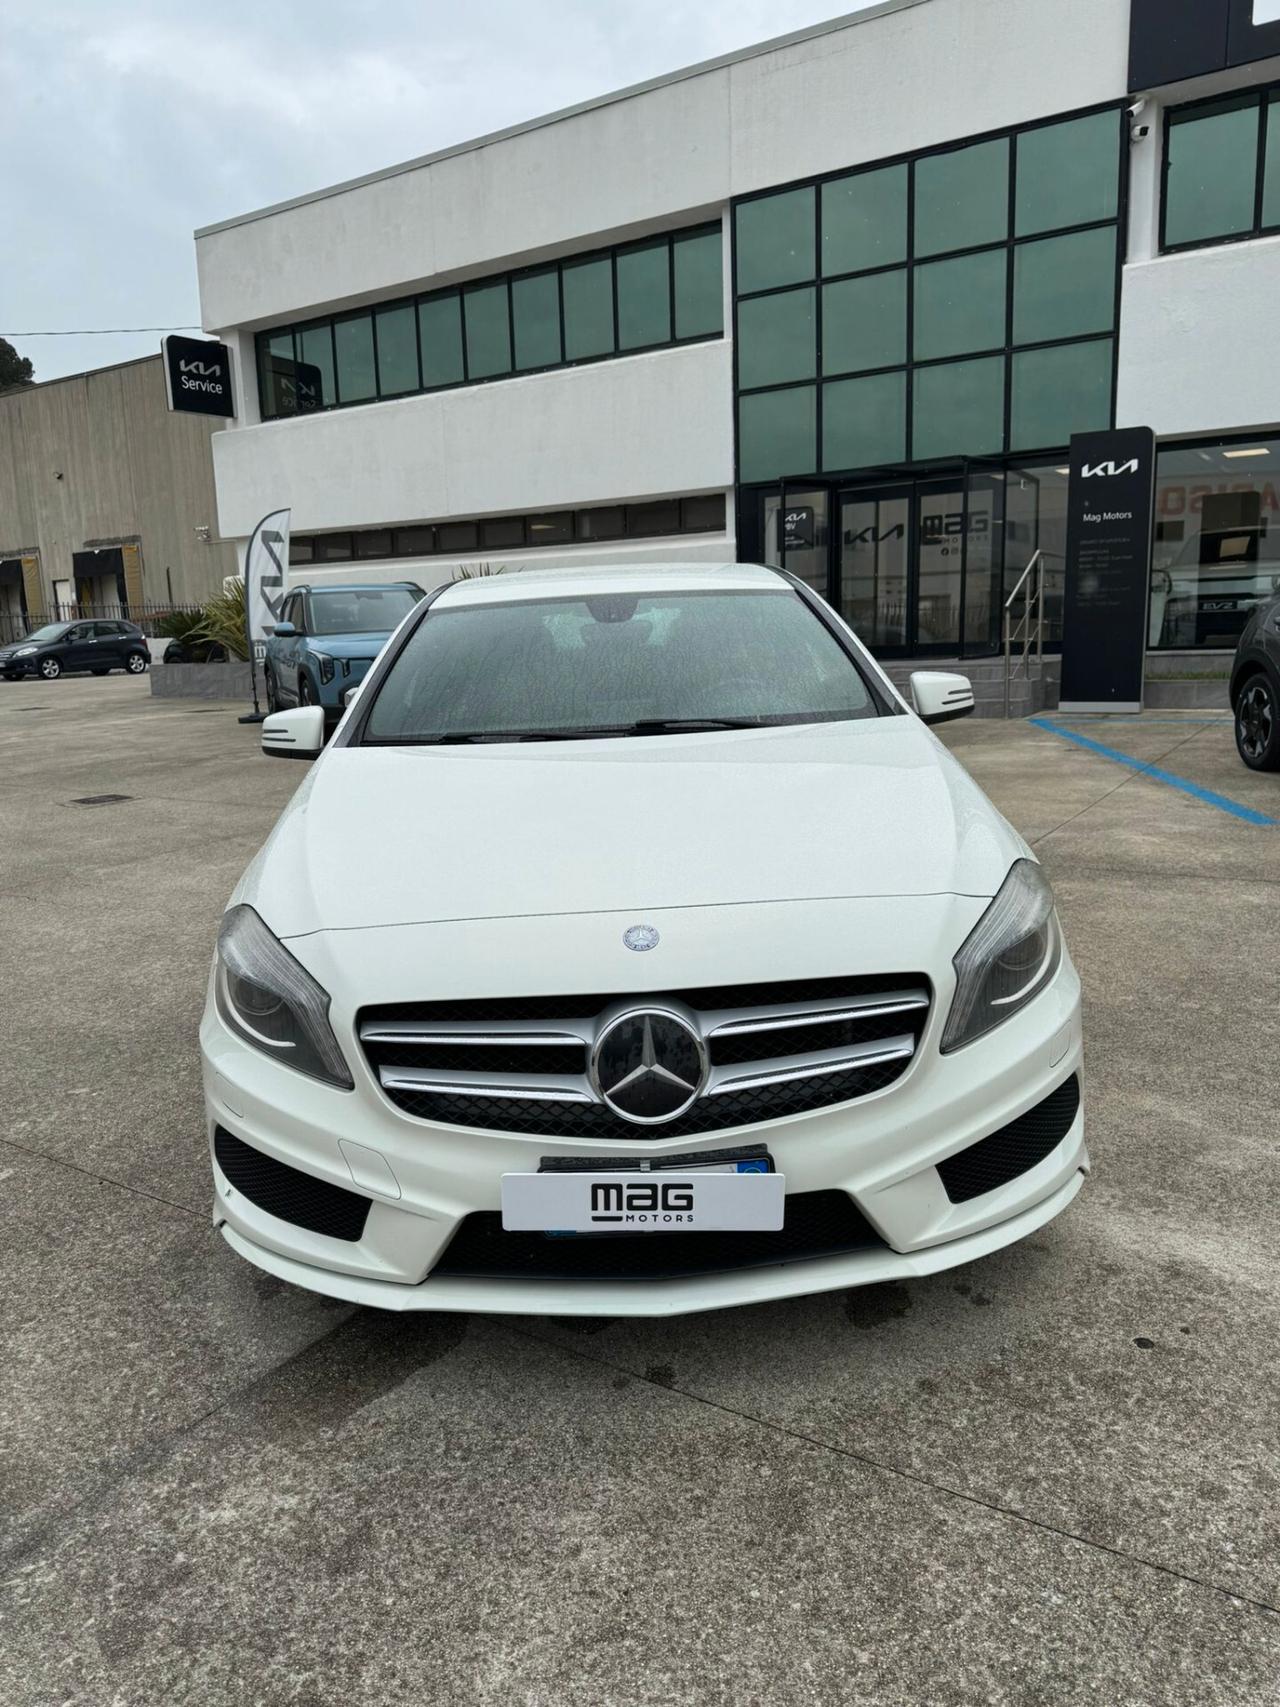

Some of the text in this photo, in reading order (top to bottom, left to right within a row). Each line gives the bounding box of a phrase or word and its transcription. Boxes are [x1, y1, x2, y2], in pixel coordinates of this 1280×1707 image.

[179, 359, 221, 377] KIA
[181, 375, 223, 394] Service
[1081, 458, 1138, 478] KIA
[1083, 512, 1132, 523] Mag Motors
[626, 1214, 694, 1222] MOTORS
